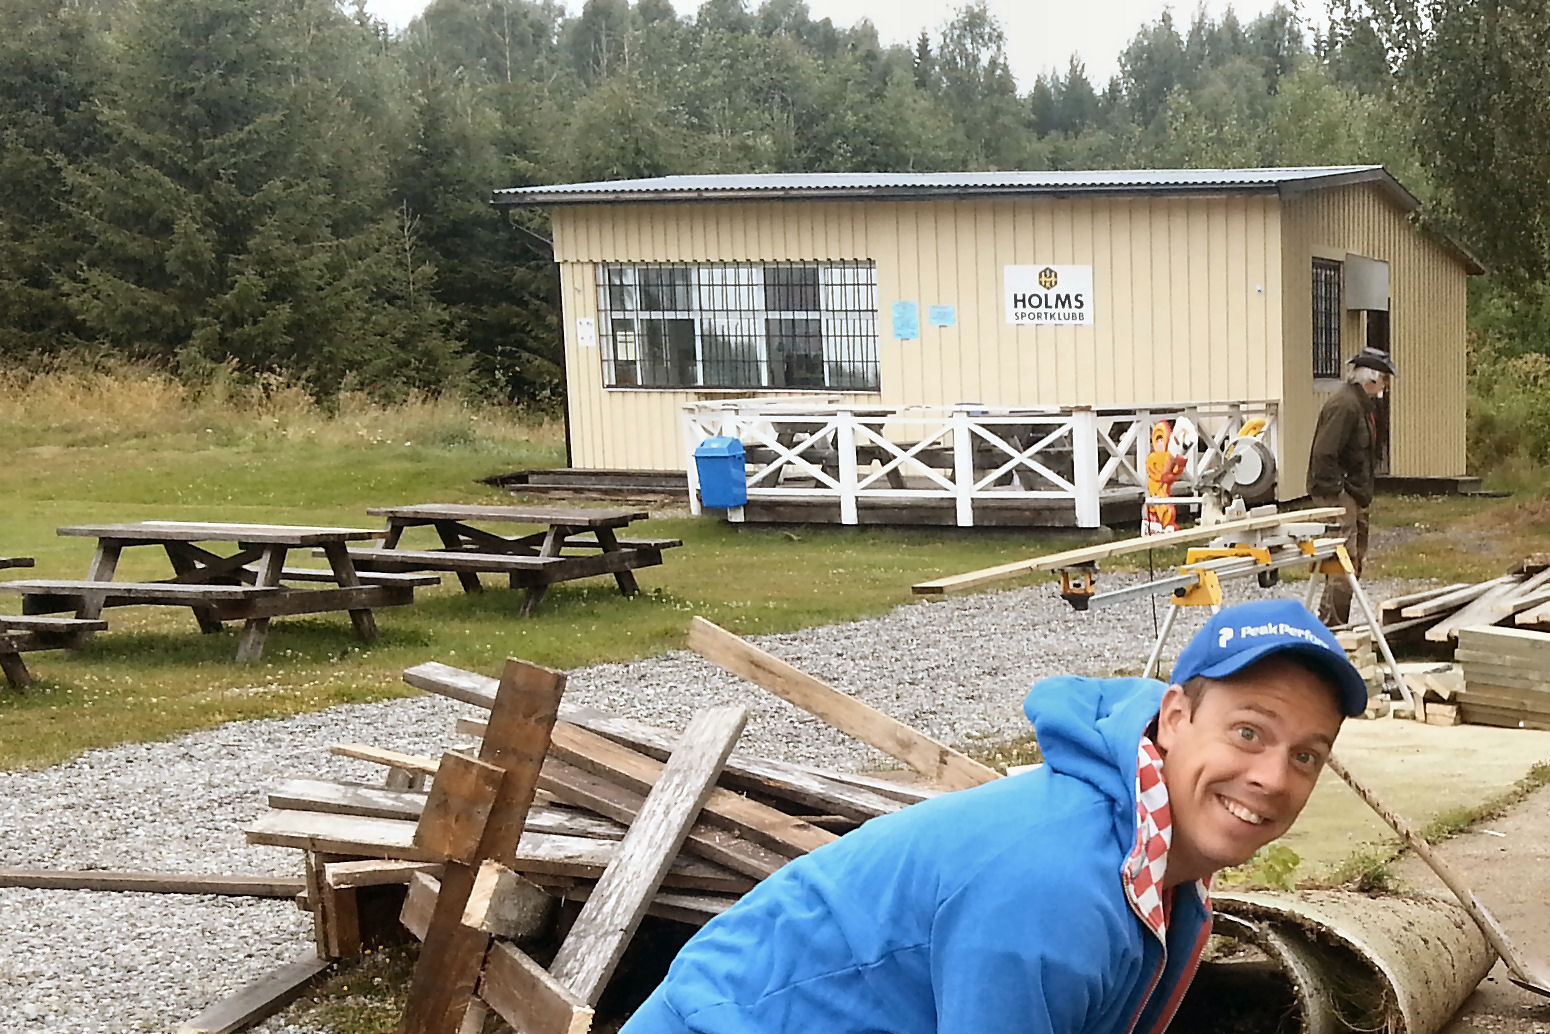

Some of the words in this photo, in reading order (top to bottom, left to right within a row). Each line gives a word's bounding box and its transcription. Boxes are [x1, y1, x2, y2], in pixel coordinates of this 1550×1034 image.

[1013, 293, 1085, 309] HOLMS
[1014, 311, 1085, 321] SPORTKLUBB
[1241, 622, 1278, 639] Peak
